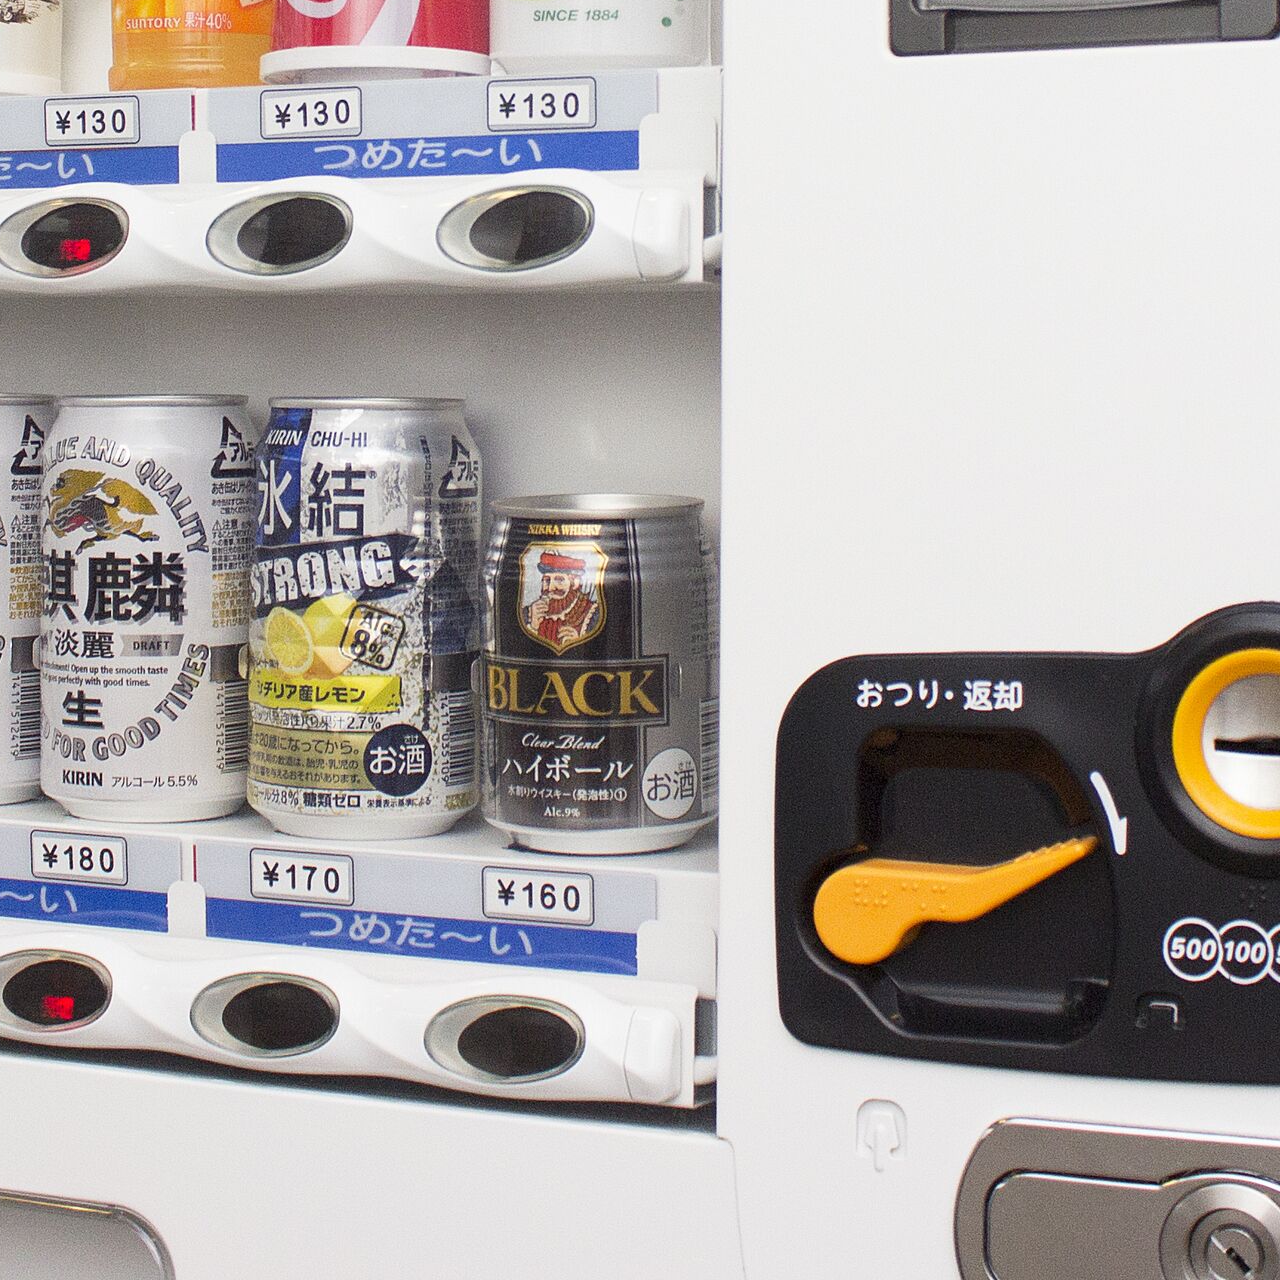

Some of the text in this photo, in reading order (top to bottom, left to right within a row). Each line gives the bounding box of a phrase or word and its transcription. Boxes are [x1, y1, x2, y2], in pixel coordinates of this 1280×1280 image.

[126, 17, 180, 30] SUNTORY
[532, 7, 621, 23] SINCE 1884
[274, 101, 352, 130] ¥130
[498, 92, 581, 120] ¥130
[55, 108, 128, 135] ¥130
[265, 430, 369, 448] KIRIN CHU-HI
[83, 435, 132, 469] AND
[134, 461, 210, 555] QUALITY
[257, 457, 366, 539] 氷結
[527, 523, 602, 537] NIKKA WHISKY
[251, 540, 395, 609] STRONG
[55, 628, 115, 659] 淡麗
[133, 640, 169, 652] DRAFT
[350, 628, 386, 666] 8%
[115, 666, 169, 676] smooth taste
[154, 643, 210, 722] TIMES
[488, 665, 661, 718] BLACK
[856, 680, 1023, 711] おつり・返却
[62, 690, 105, 730] 生
[346, 716, 382, 731] 2.7%
[51, 716, 161, 762] FOR GOOD
[521, 732, 605, 751] Clear Blend
[370, 744, 426, 776] お酒
[502, 754, 634, 783] ハイボール
[62, 768, 199, 789] KIRIN アルコール 5.5%
[647, 768, 695, 802] お酒
[303, 792, 361, 809] 糖類ゼロ
[543, 807, 581, 818] Alc.9%
[41, 844, 115, 873] ¥180
[261, 862, 341, 893] ¥170
[498, 880, 582, 911] ¥160
[1172, 938, 1216, 962] 500
[1224, 940, 1266, 964] 100
